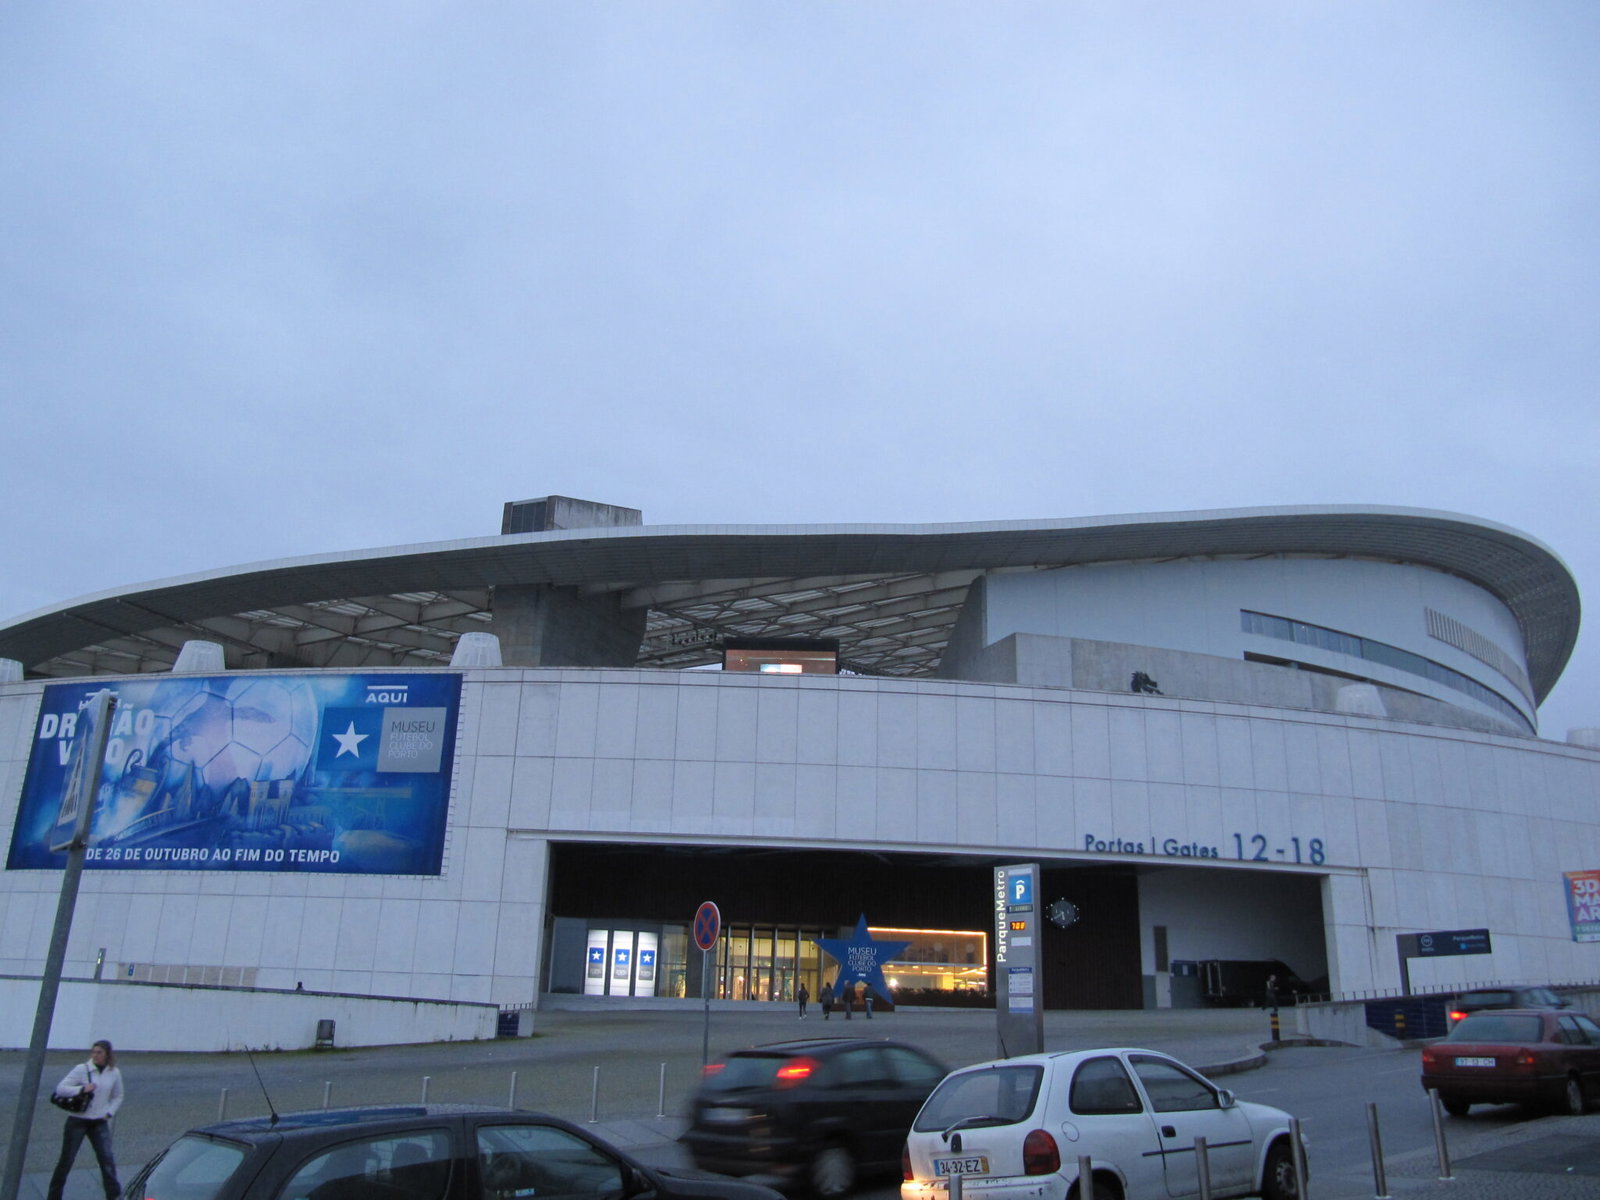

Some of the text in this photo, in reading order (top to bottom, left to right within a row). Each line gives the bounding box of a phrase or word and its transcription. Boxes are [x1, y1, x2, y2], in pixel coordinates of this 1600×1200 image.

[365, 692, 408, 704] AQUI
[39, 703, 155, 739] DRÃO
[391, 720, 436, 733] MUSEU
[390, 732, 429, 741] FUTEBOL
[389, 742, 433, 750] CLUBE DO
[387, 750, 418, 759] PORTO
[1084, 833, 1145, 854] Portas
[1162, 838, 1218, 858] Gates
[85, 848, 340, 863] DE 26 DE OUTUBRO AO FIM DO TEMPO
[1573, 879, 1599, 894] 3D
[996, 870, 1009, 963] ParqueMetro
[848, 947, 877, 955] MUSEU
[940, 1160, 980, 1173] 34-32-EZ
